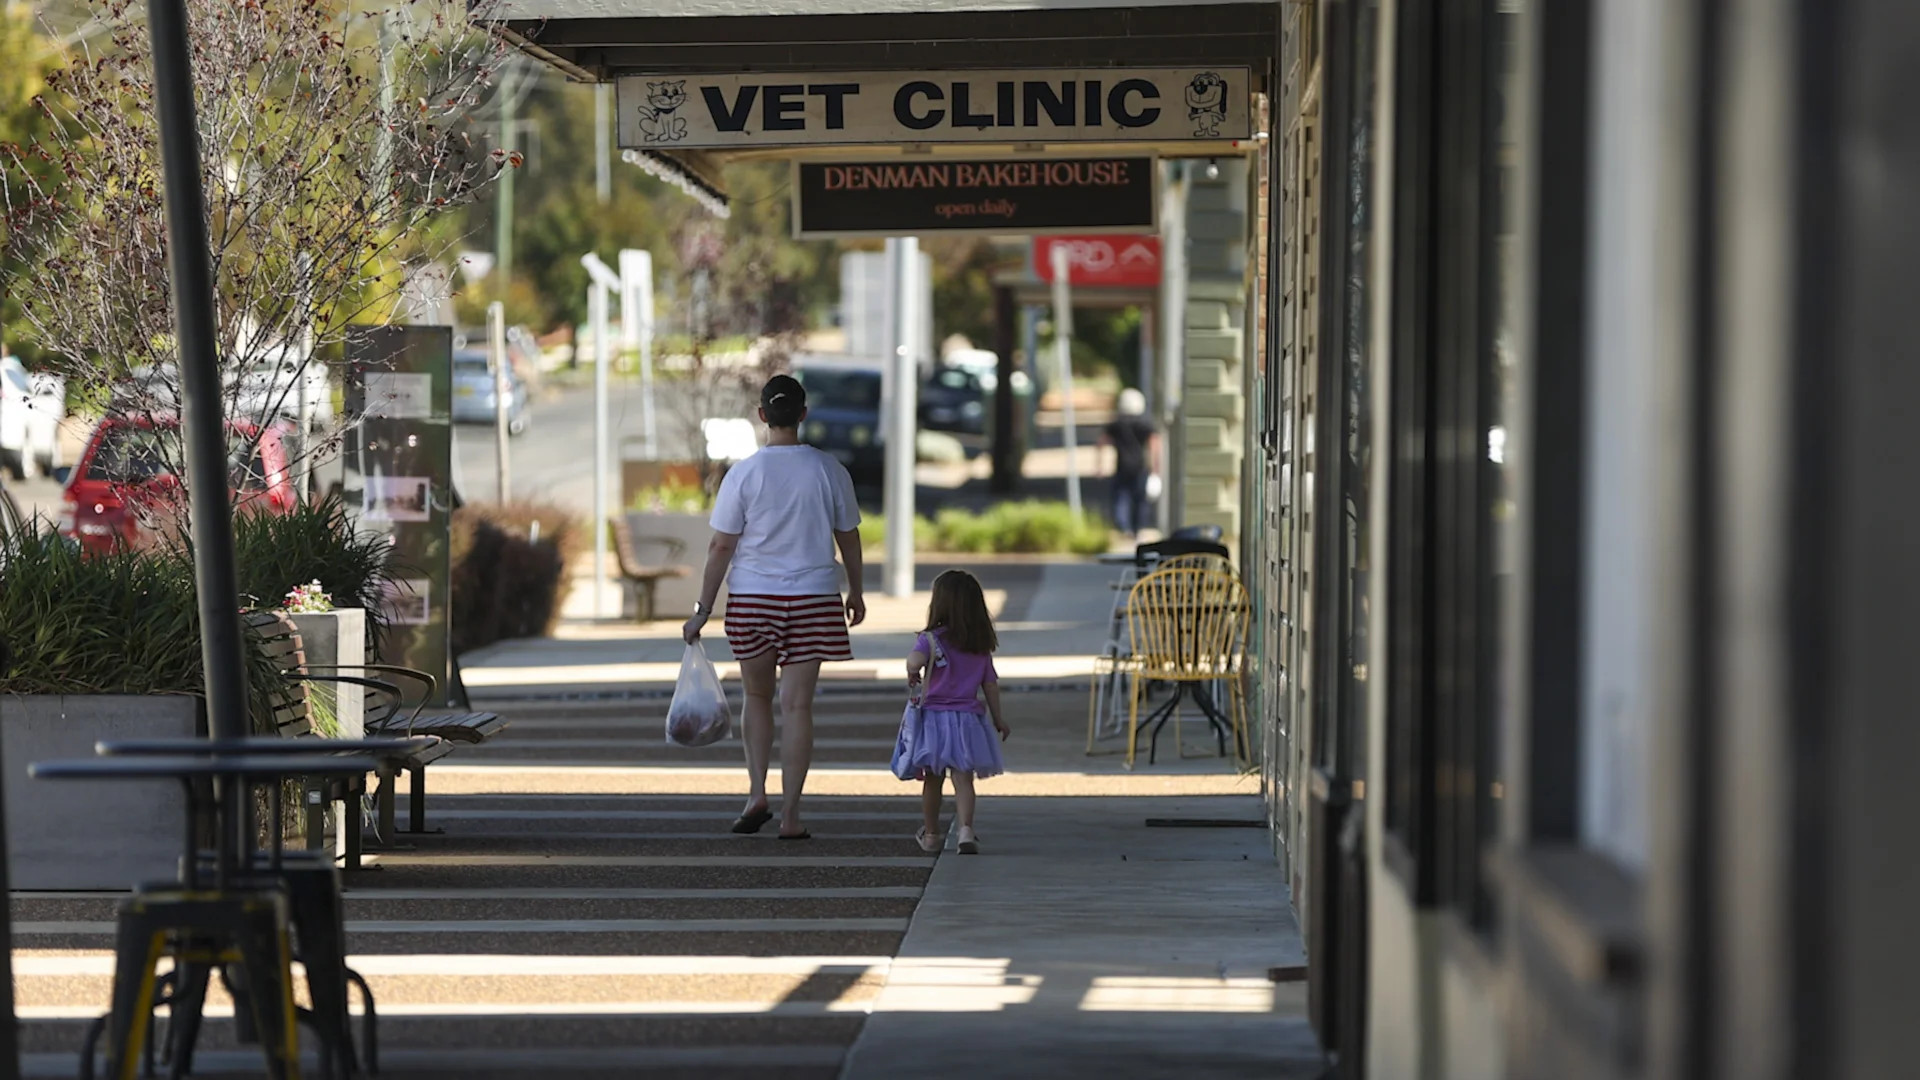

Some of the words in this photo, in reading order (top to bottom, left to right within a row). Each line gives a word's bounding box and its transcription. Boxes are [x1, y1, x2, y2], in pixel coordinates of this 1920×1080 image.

[700, 83, 860, 131] VET
[893, 79, 1161, 130] CLINIC
[824, 166, 949, 189] DENMAN
[957, 161, 1129, 187] BAKEHOUSE
[935, 203, 976, 218] open
[979, 199, 1016, 217] daily
